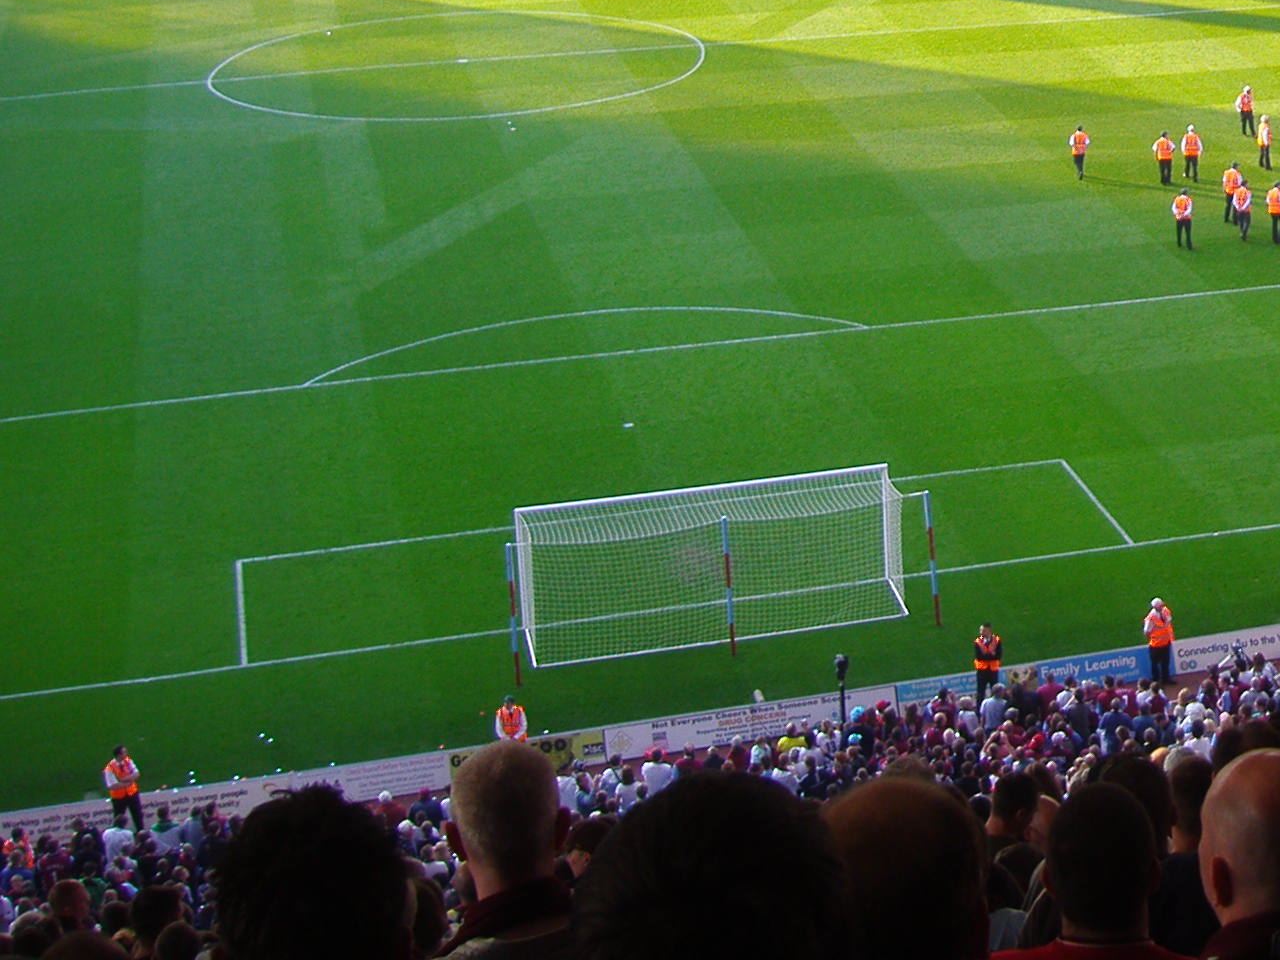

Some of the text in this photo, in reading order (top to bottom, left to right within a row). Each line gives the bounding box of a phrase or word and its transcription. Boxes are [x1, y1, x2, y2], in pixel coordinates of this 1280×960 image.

[1177, 642, 1230, 658] Connecting
[1249, 638, 1259, 646] to
[1261, 635, 1276, 645] the
[1041, 655, 1137, 679] Family Learning
[652, 721, 668, 729] Not
